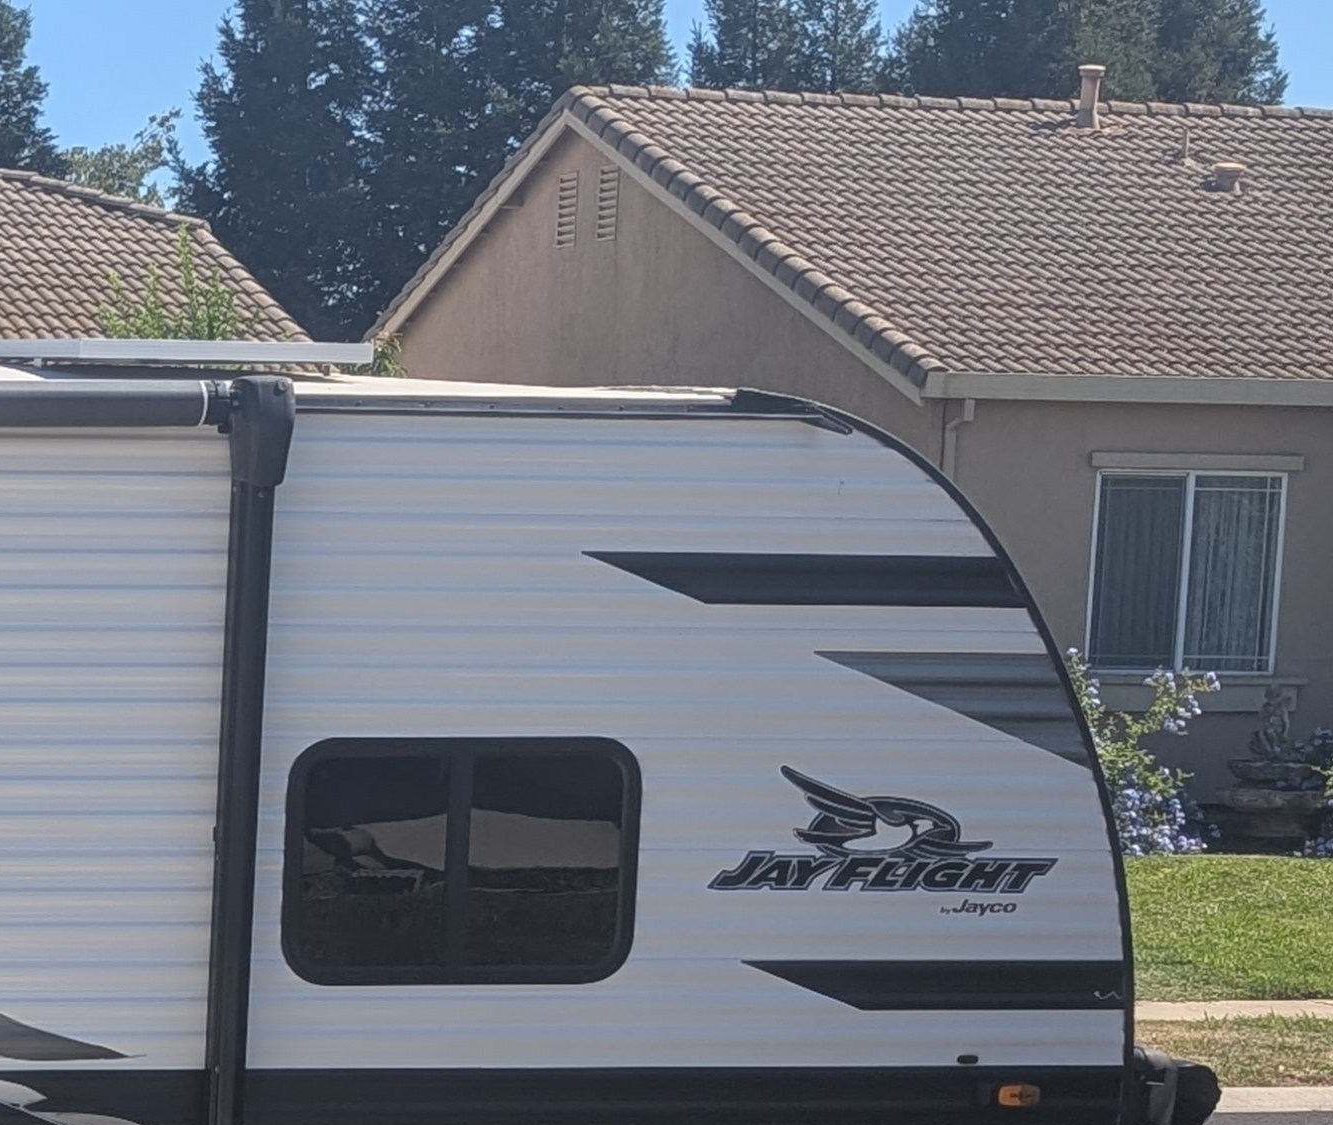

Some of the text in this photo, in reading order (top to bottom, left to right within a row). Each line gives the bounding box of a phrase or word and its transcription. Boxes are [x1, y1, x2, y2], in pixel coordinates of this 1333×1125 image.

[707, 850, 1059, 895] JAY FLIGHT
[952, 899, 1018, 917] Jayco
